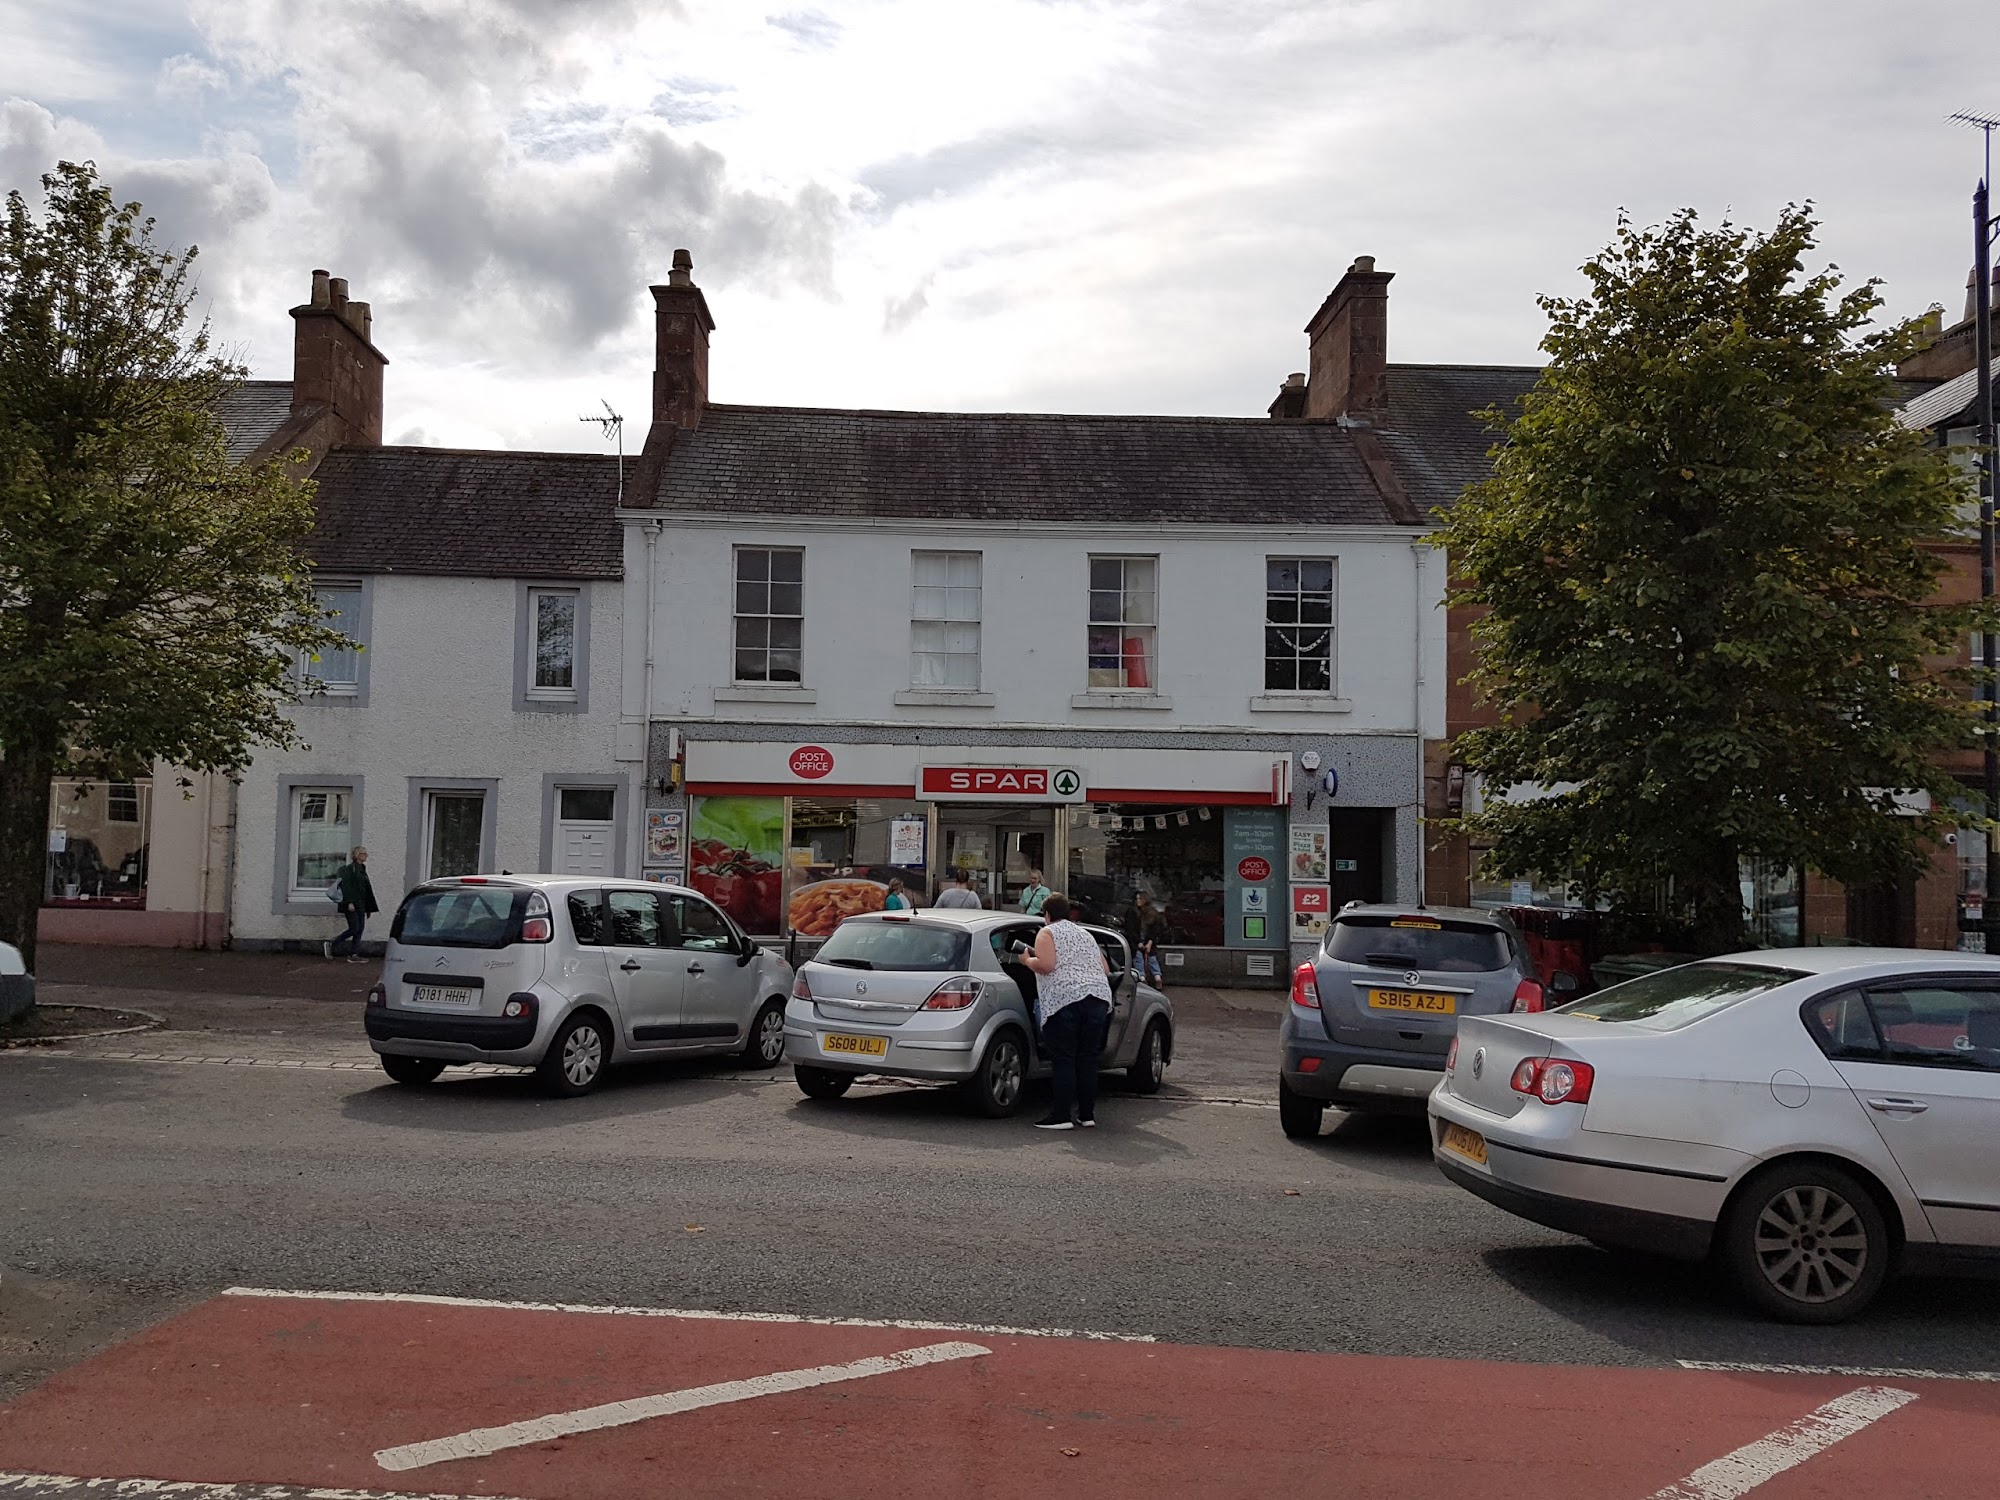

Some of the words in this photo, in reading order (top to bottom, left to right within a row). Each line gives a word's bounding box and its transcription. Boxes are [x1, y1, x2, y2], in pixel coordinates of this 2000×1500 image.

[800, 753, 825, 761] POST
[793, 762, 828, 771] OFFICE
[950, 772, 1045, 790] SPAR
[1240, 868, 1267, 876] OFFICE
[1301, 894, 1321, 905] £2
[418, 988, 441, 1001] 0181
[445, 990, 467, 1003] HHH
[1378, 992, 1412, 1007] SB15
[1416, 995, 1446, 1010] AZJ
[828, 1036, 857, 1051] SG08
[860, 1038, 881, 1053] ULJ
